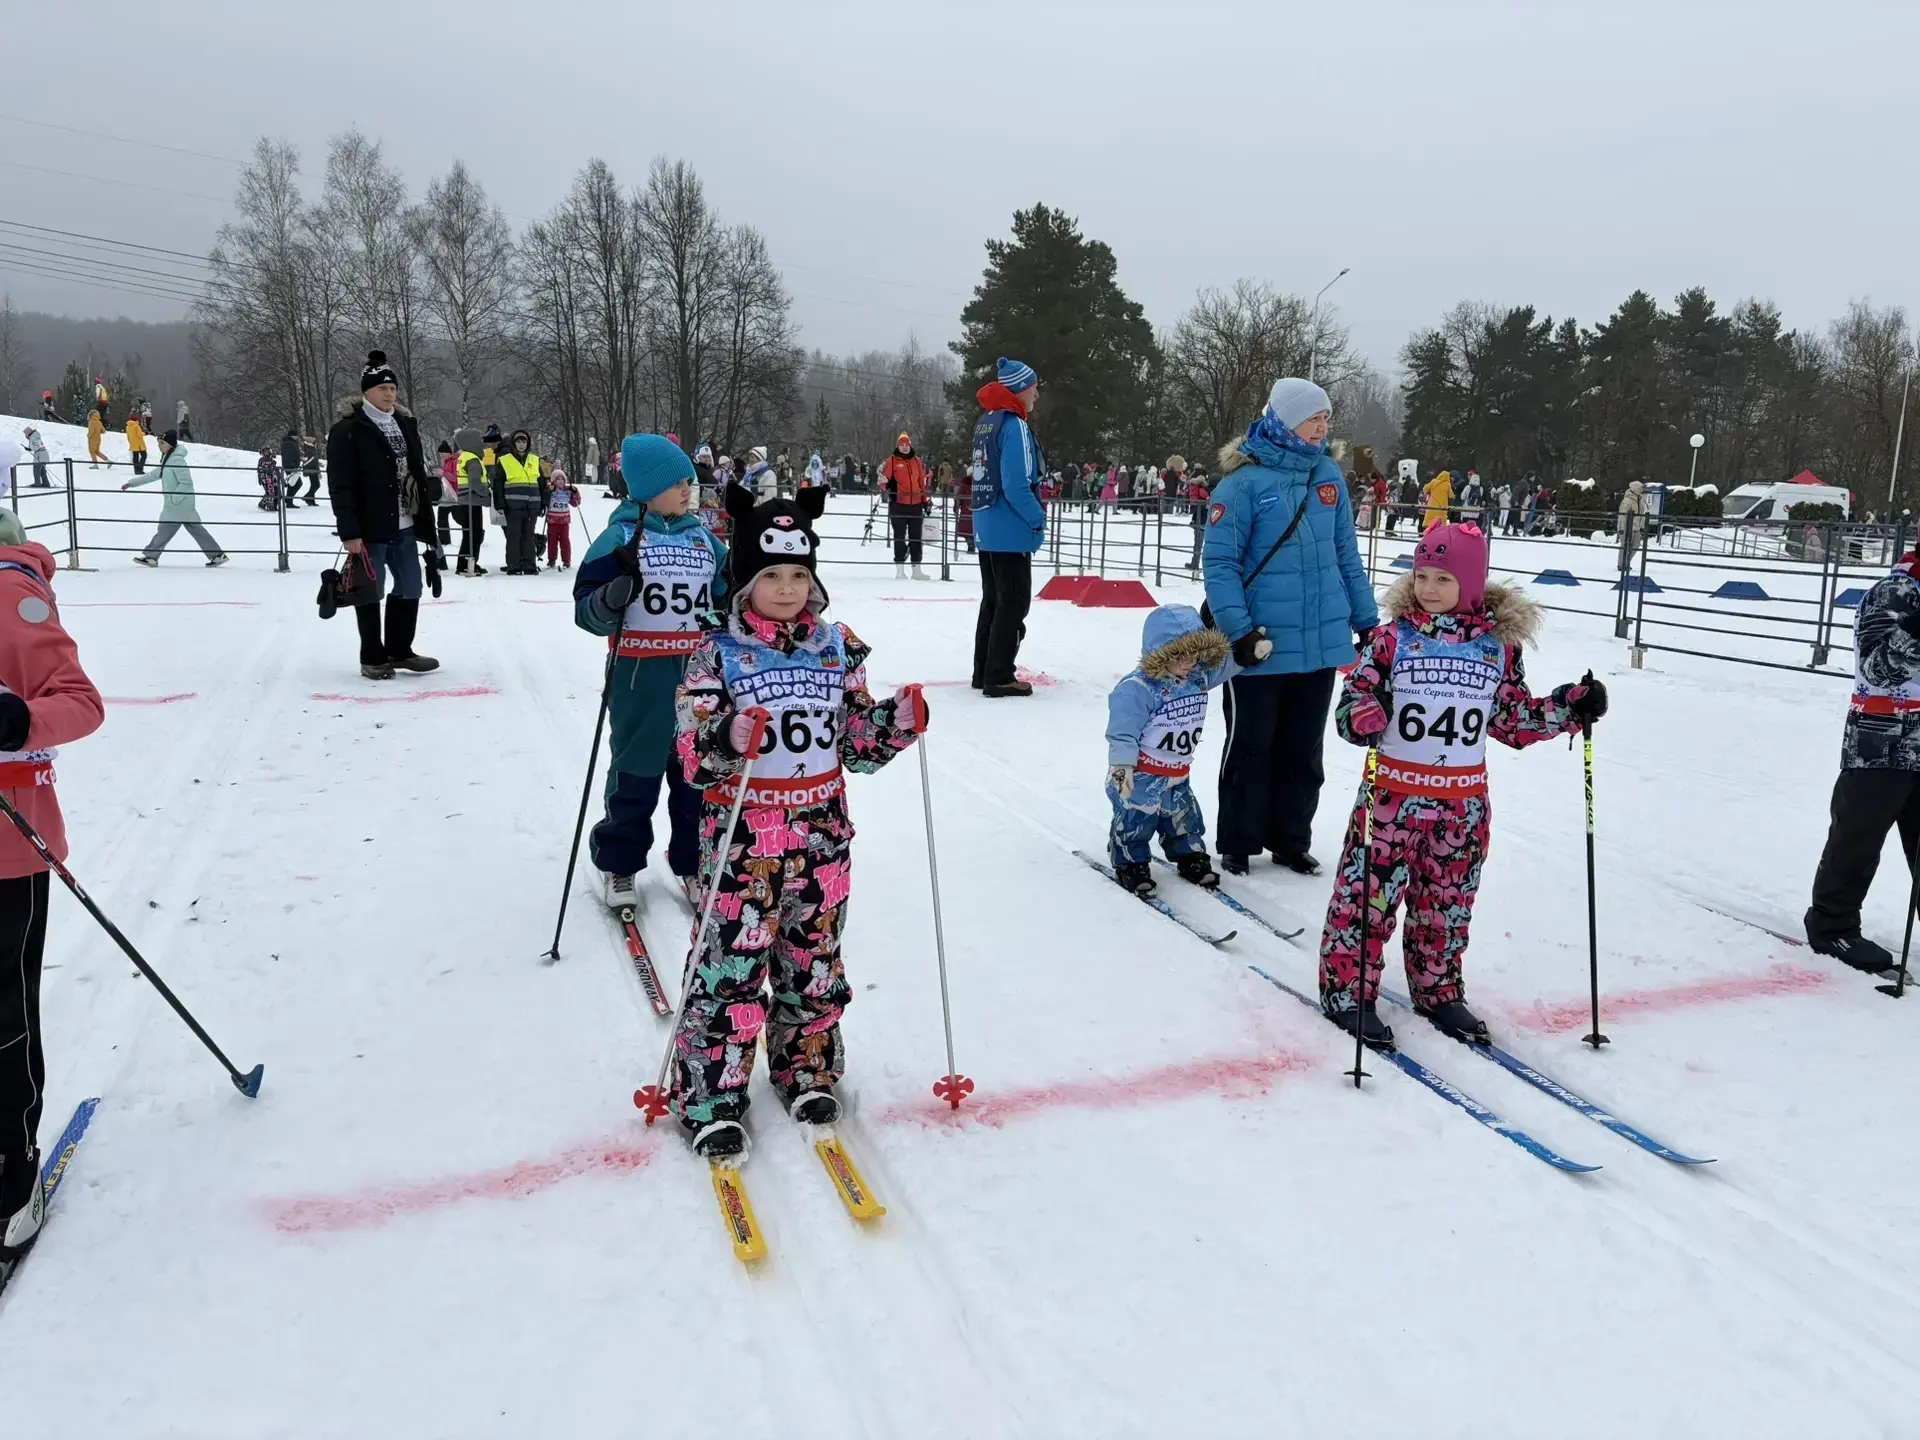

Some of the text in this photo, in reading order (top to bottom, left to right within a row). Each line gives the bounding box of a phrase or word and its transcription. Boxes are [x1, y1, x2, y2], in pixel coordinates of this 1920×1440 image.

[637, 546, 714, 564] РЕЩЕНСКИ
[648, 555, 702, 568] МОРОЗЫ
[643, 582, 710, 616] 654
[732, 668, 844, 694] КРЕЩЕНСКИ
[1393, 658, 1499, 682] КРЕЩЕНСКИ
[1412, 670, 1485, 688] МОРОЗЫ
[756, 683, 829, 702] МОРОЗЫ
[1423, 687, 1455, 699] Сергея
[677, 702, 688, 712] SKI
[1398, 702, 1484, 747] 649
[742, 808, 786, 833] TOM
[634, 955, 661, 1003] NORDWAY
[44, 1141, 78, 1192] NERGY
